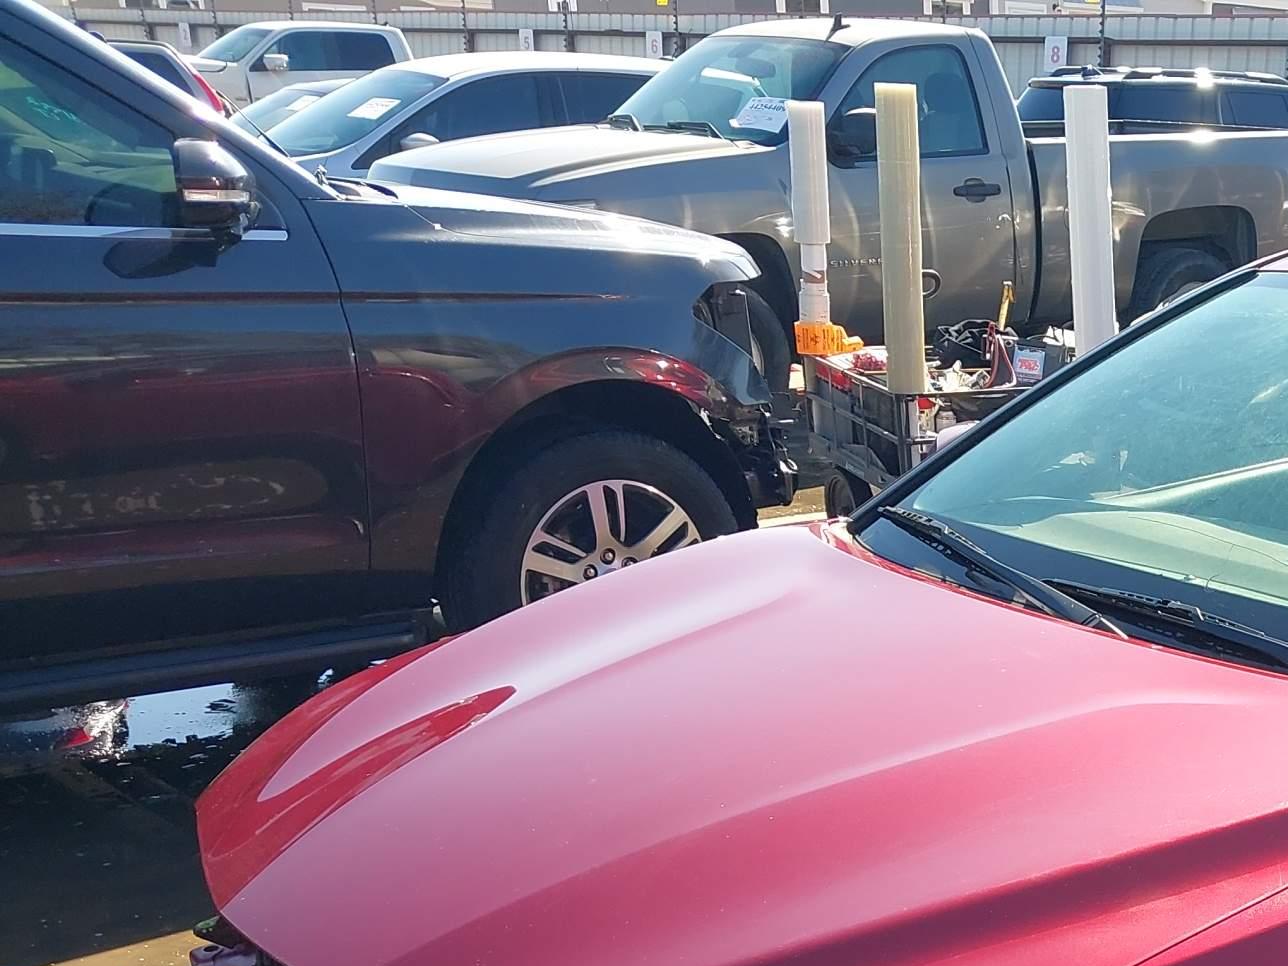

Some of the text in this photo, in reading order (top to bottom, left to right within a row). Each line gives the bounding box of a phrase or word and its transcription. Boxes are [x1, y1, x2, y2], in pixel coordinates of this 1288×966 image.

[523, 36, 530, 50] 5
[651, 39, 658, 54] 6
[1050, 45, 1060, 64] 8
